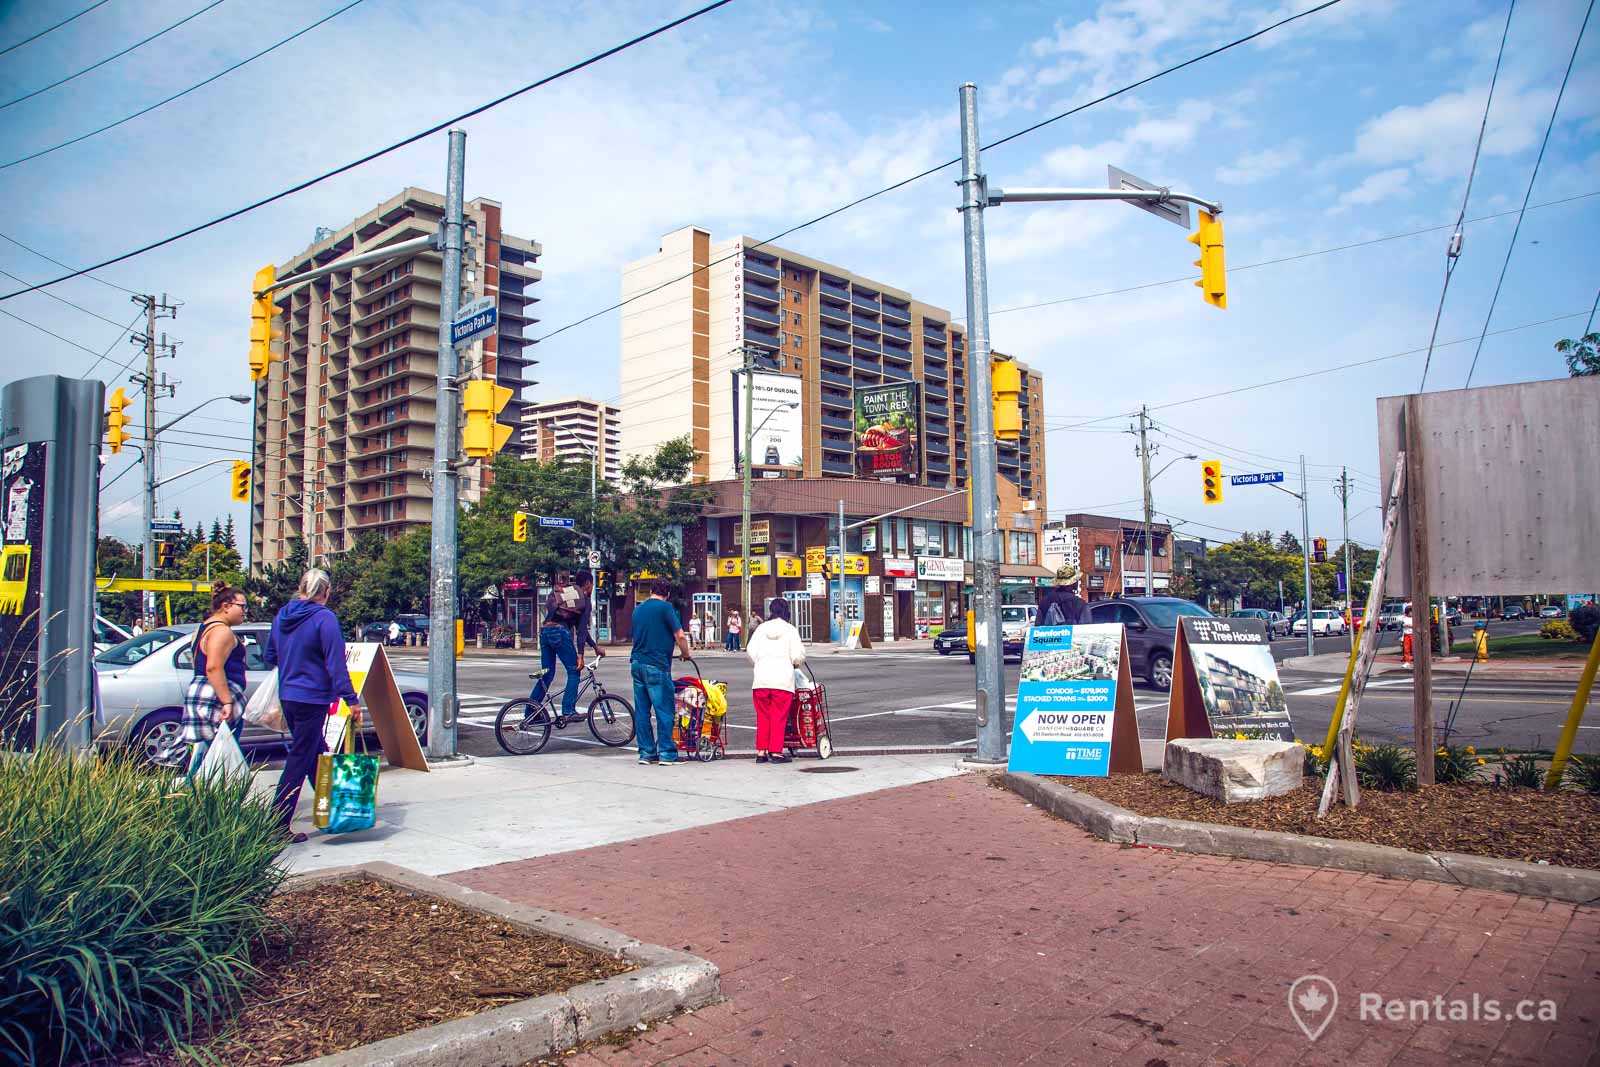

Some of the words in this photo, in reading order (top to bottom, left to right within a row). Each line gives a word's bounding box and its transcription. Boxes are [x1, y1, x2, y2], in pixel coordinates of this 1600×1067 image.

[454, 320, 474, 339] Victoria
[473, 314, 486, 330] Park
[864, 393, 888, 405] PAINT
[889, 390, 907, 401] THE
[864, 402, 889, 414] TOWN
[1232, 474, 1258, 484] Victoria
[1260, 472, 1276, 482] Park
[833, 604, 859, 620] FEE
[1212, 621, 1231, 632] The
[1032, 629, 1071, 638] Danforth
[1211, 631, 1234, 643] Tree
[1233, 632, 1262, 643] House
[1032, 636, 1063, 646] Square
[1045, 687, 1074, 695] CONDOS
[1037, 714, 1068, 725] NOW
[1071, 714, 1107, 726] OPEN
[1077, 747, 1103, 758] TIME
